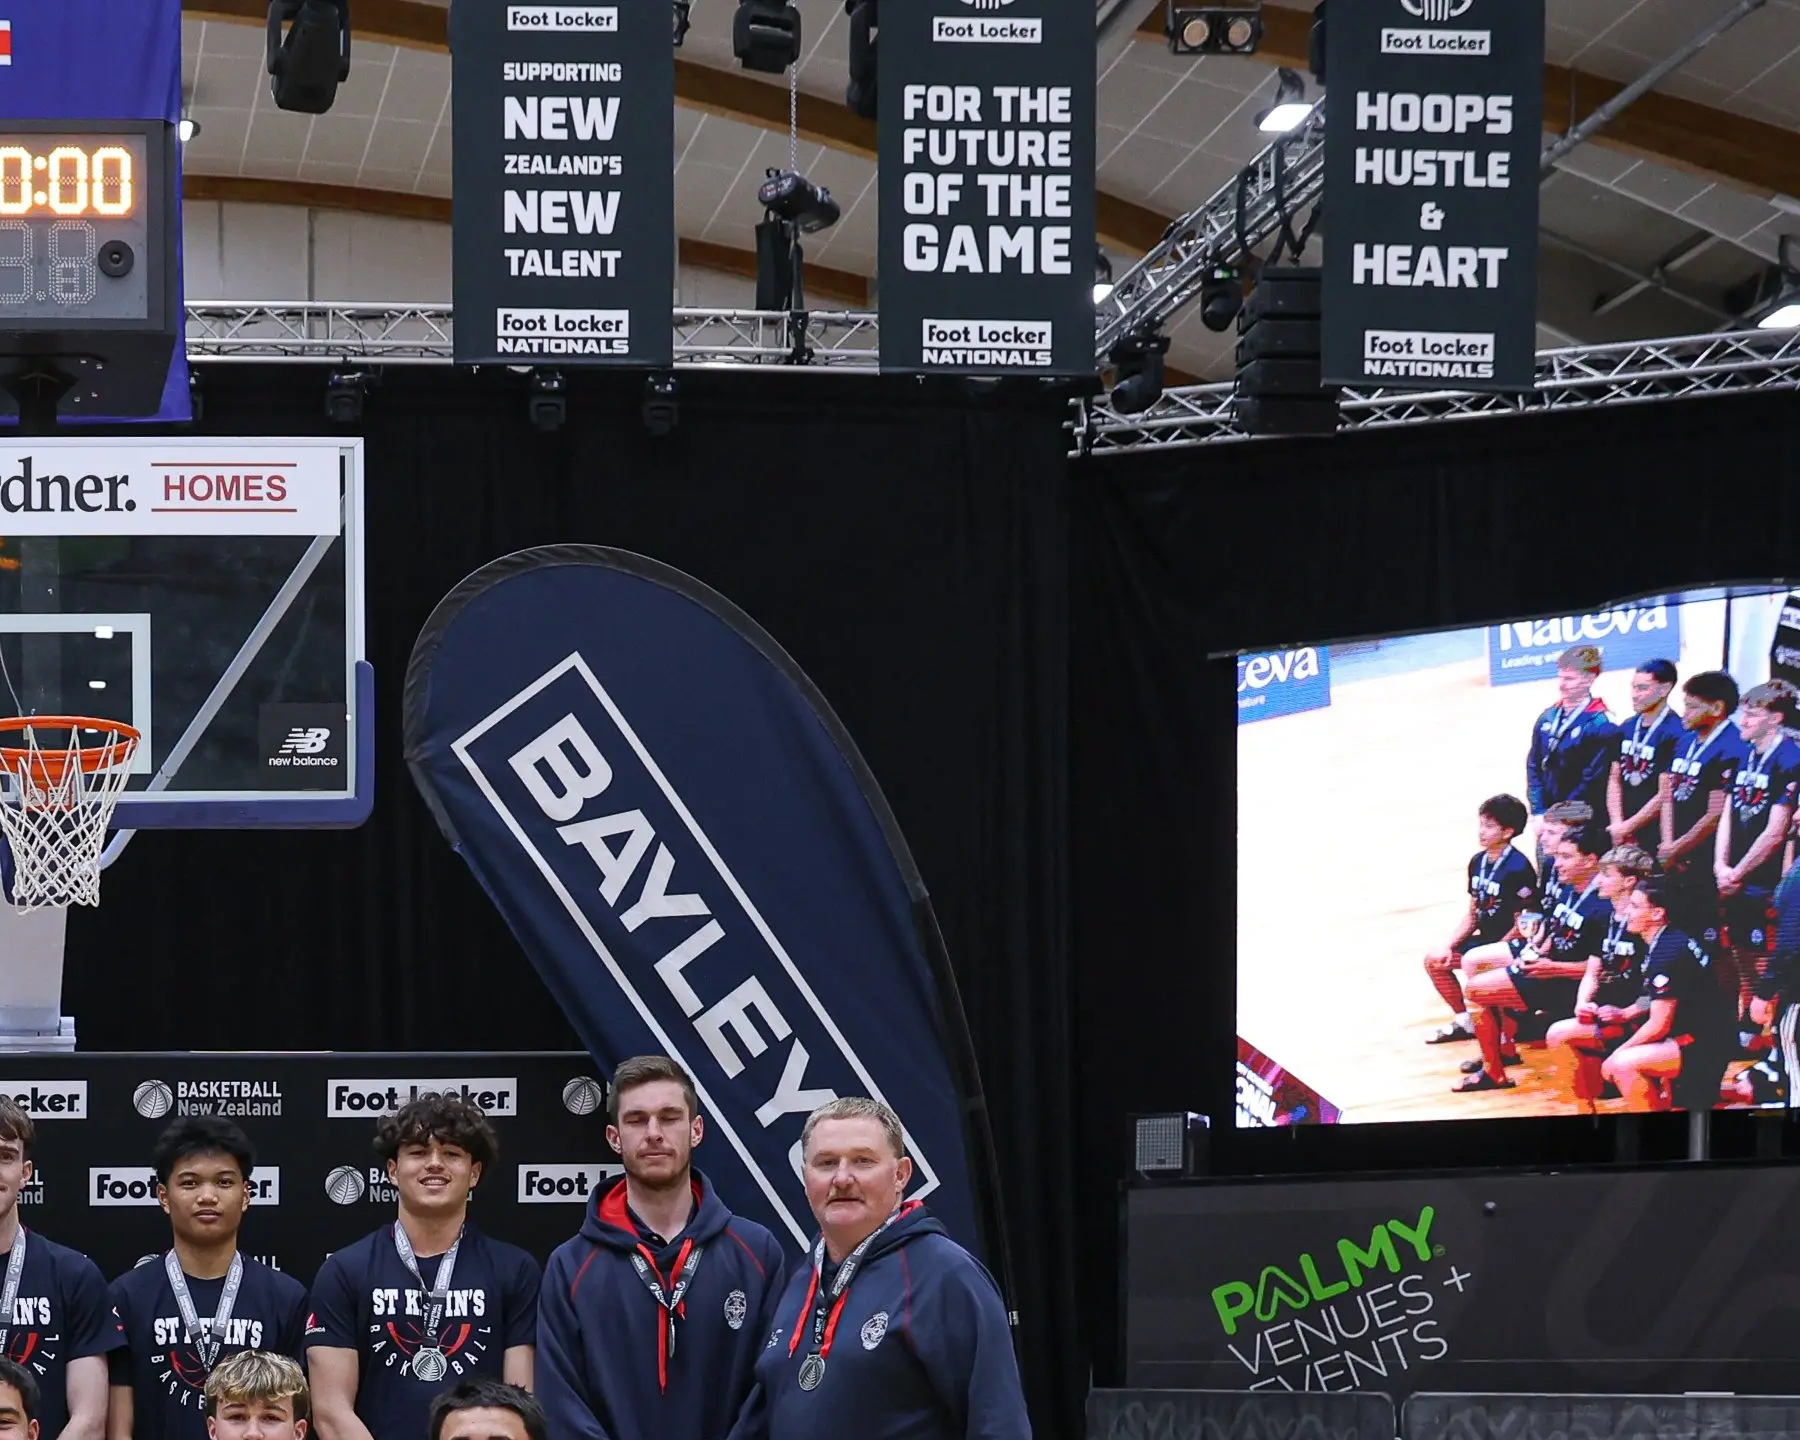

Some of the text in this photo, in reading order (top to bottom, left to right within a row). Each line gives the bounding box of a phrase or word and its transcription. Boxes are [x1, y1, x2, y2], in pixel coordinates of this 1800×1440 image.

[512, 10, 613, 28] Foot Locker
[937, 21, 1037, 39] Foot Locker
[1386, 34, 1486, 53] Foot Locker
[503, 62, 622, 82] SUPPORTING
[903, 84, 1071, 122] FOR THE
[1356, 92, 1512, 134] HOOPS
[504, 97, 620, 140] NEW
[903, 128, 1071, 167] FUTURE
[504, 154, 622, 175] ZEALAND'S
[1355, 148, 1510, 188] HUSTLE
[903, 172, 1071, 217] OF THE
[504, 190, 620, 234] NEW
[1420, 201, 1445, 230] &
[504, 249, 622, 278] TALENT
[903, 224, 1071, 275] GAME
[1352, 243, 1508, 288] HEART
[503, 312, 624, 333] Foot Locker
[928, 324, 1047, 345] Foot Locker
[497, 337, 629, 354] NATIONALS
[922, 348, 1052, 366] NATIONALS
[1370, 335, 1489, 358] Foot Locker
[1364, 360, 1493, 379] NATIONALS
[163, 474, 288, 502] HOMES
[268, 755, 338, 767] new balance
[508, 713, 838, 1188] BAYLEY
[178, 1081, 281, 1098] BASKETBALL
[178, 1099, 281, 1116] New Zealand
[526, 1170, 587, 1196] Foot
[1212, 1206, 1434, 1334] PALMY
[372, 1288, 399, 1316] ST
[154, 1317, 179, 1346] ST
[1228, 1275, 1434, 1374] VENUES
[1250, 1320, 1448, 1391] VENTS
